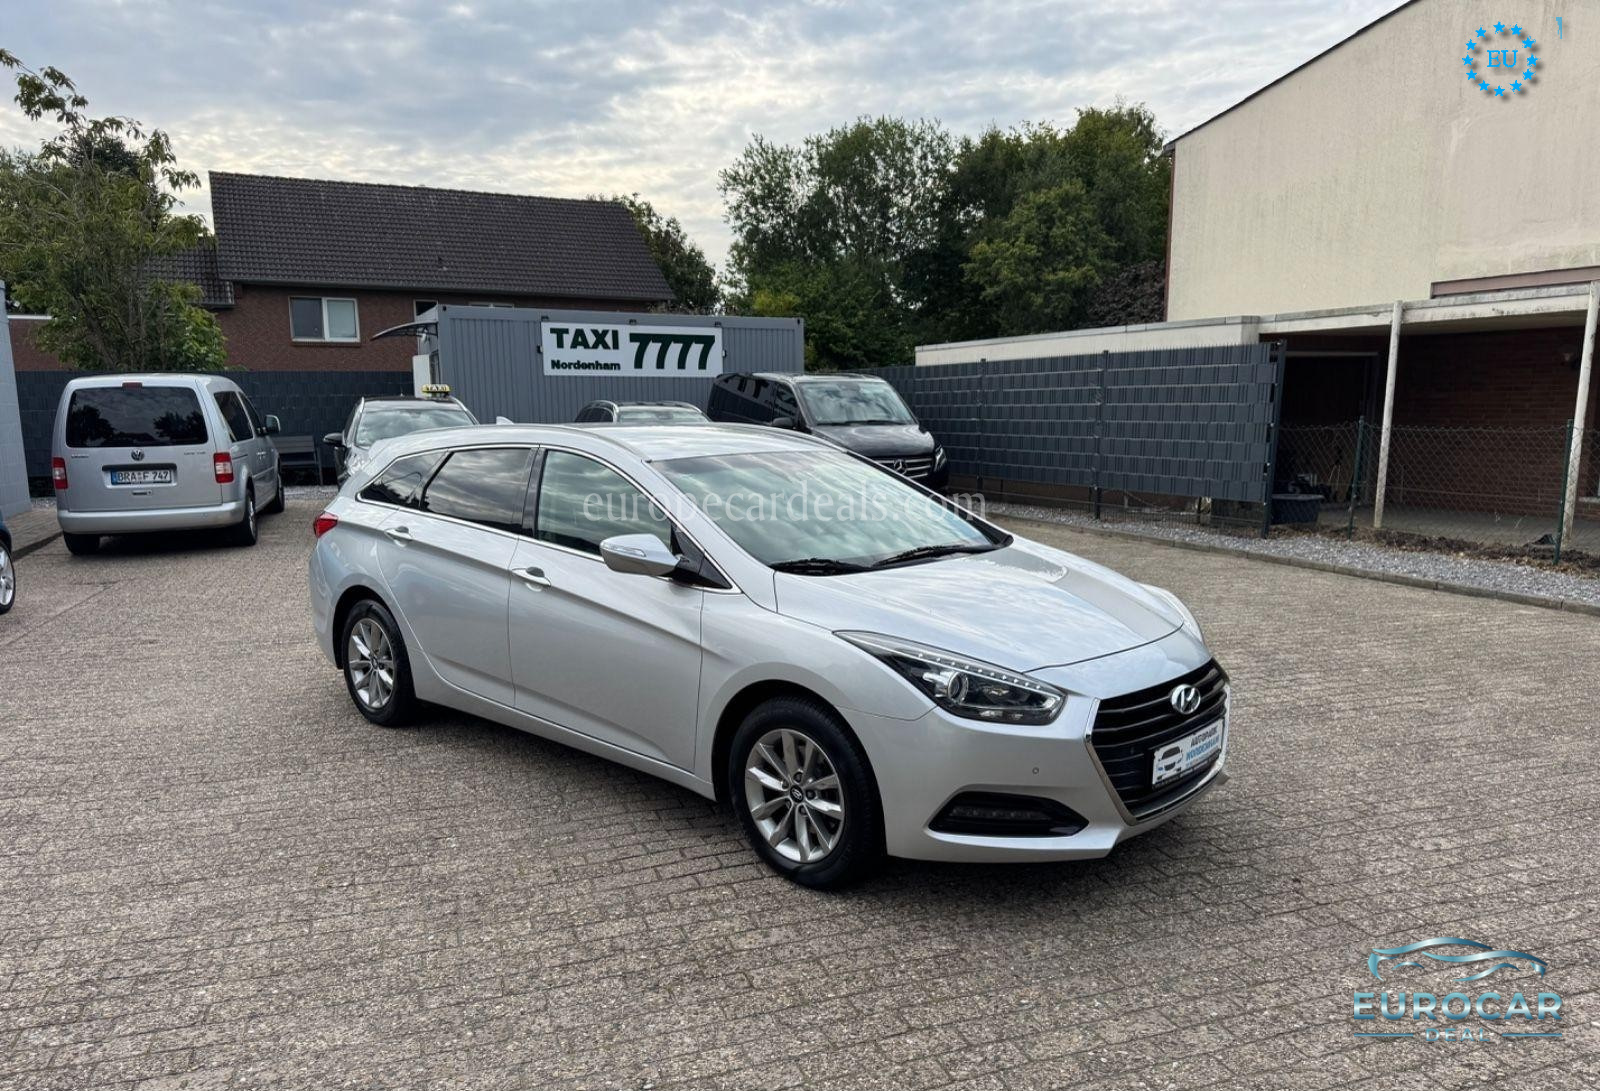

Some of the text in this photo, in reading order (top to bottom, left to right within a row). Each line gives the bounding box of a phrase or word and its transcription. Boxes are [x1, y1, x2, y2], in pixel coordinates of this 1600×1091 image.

[549, 327, 716, 370] TAXI 7777
[550, 359, 621, 371] Nordenham
